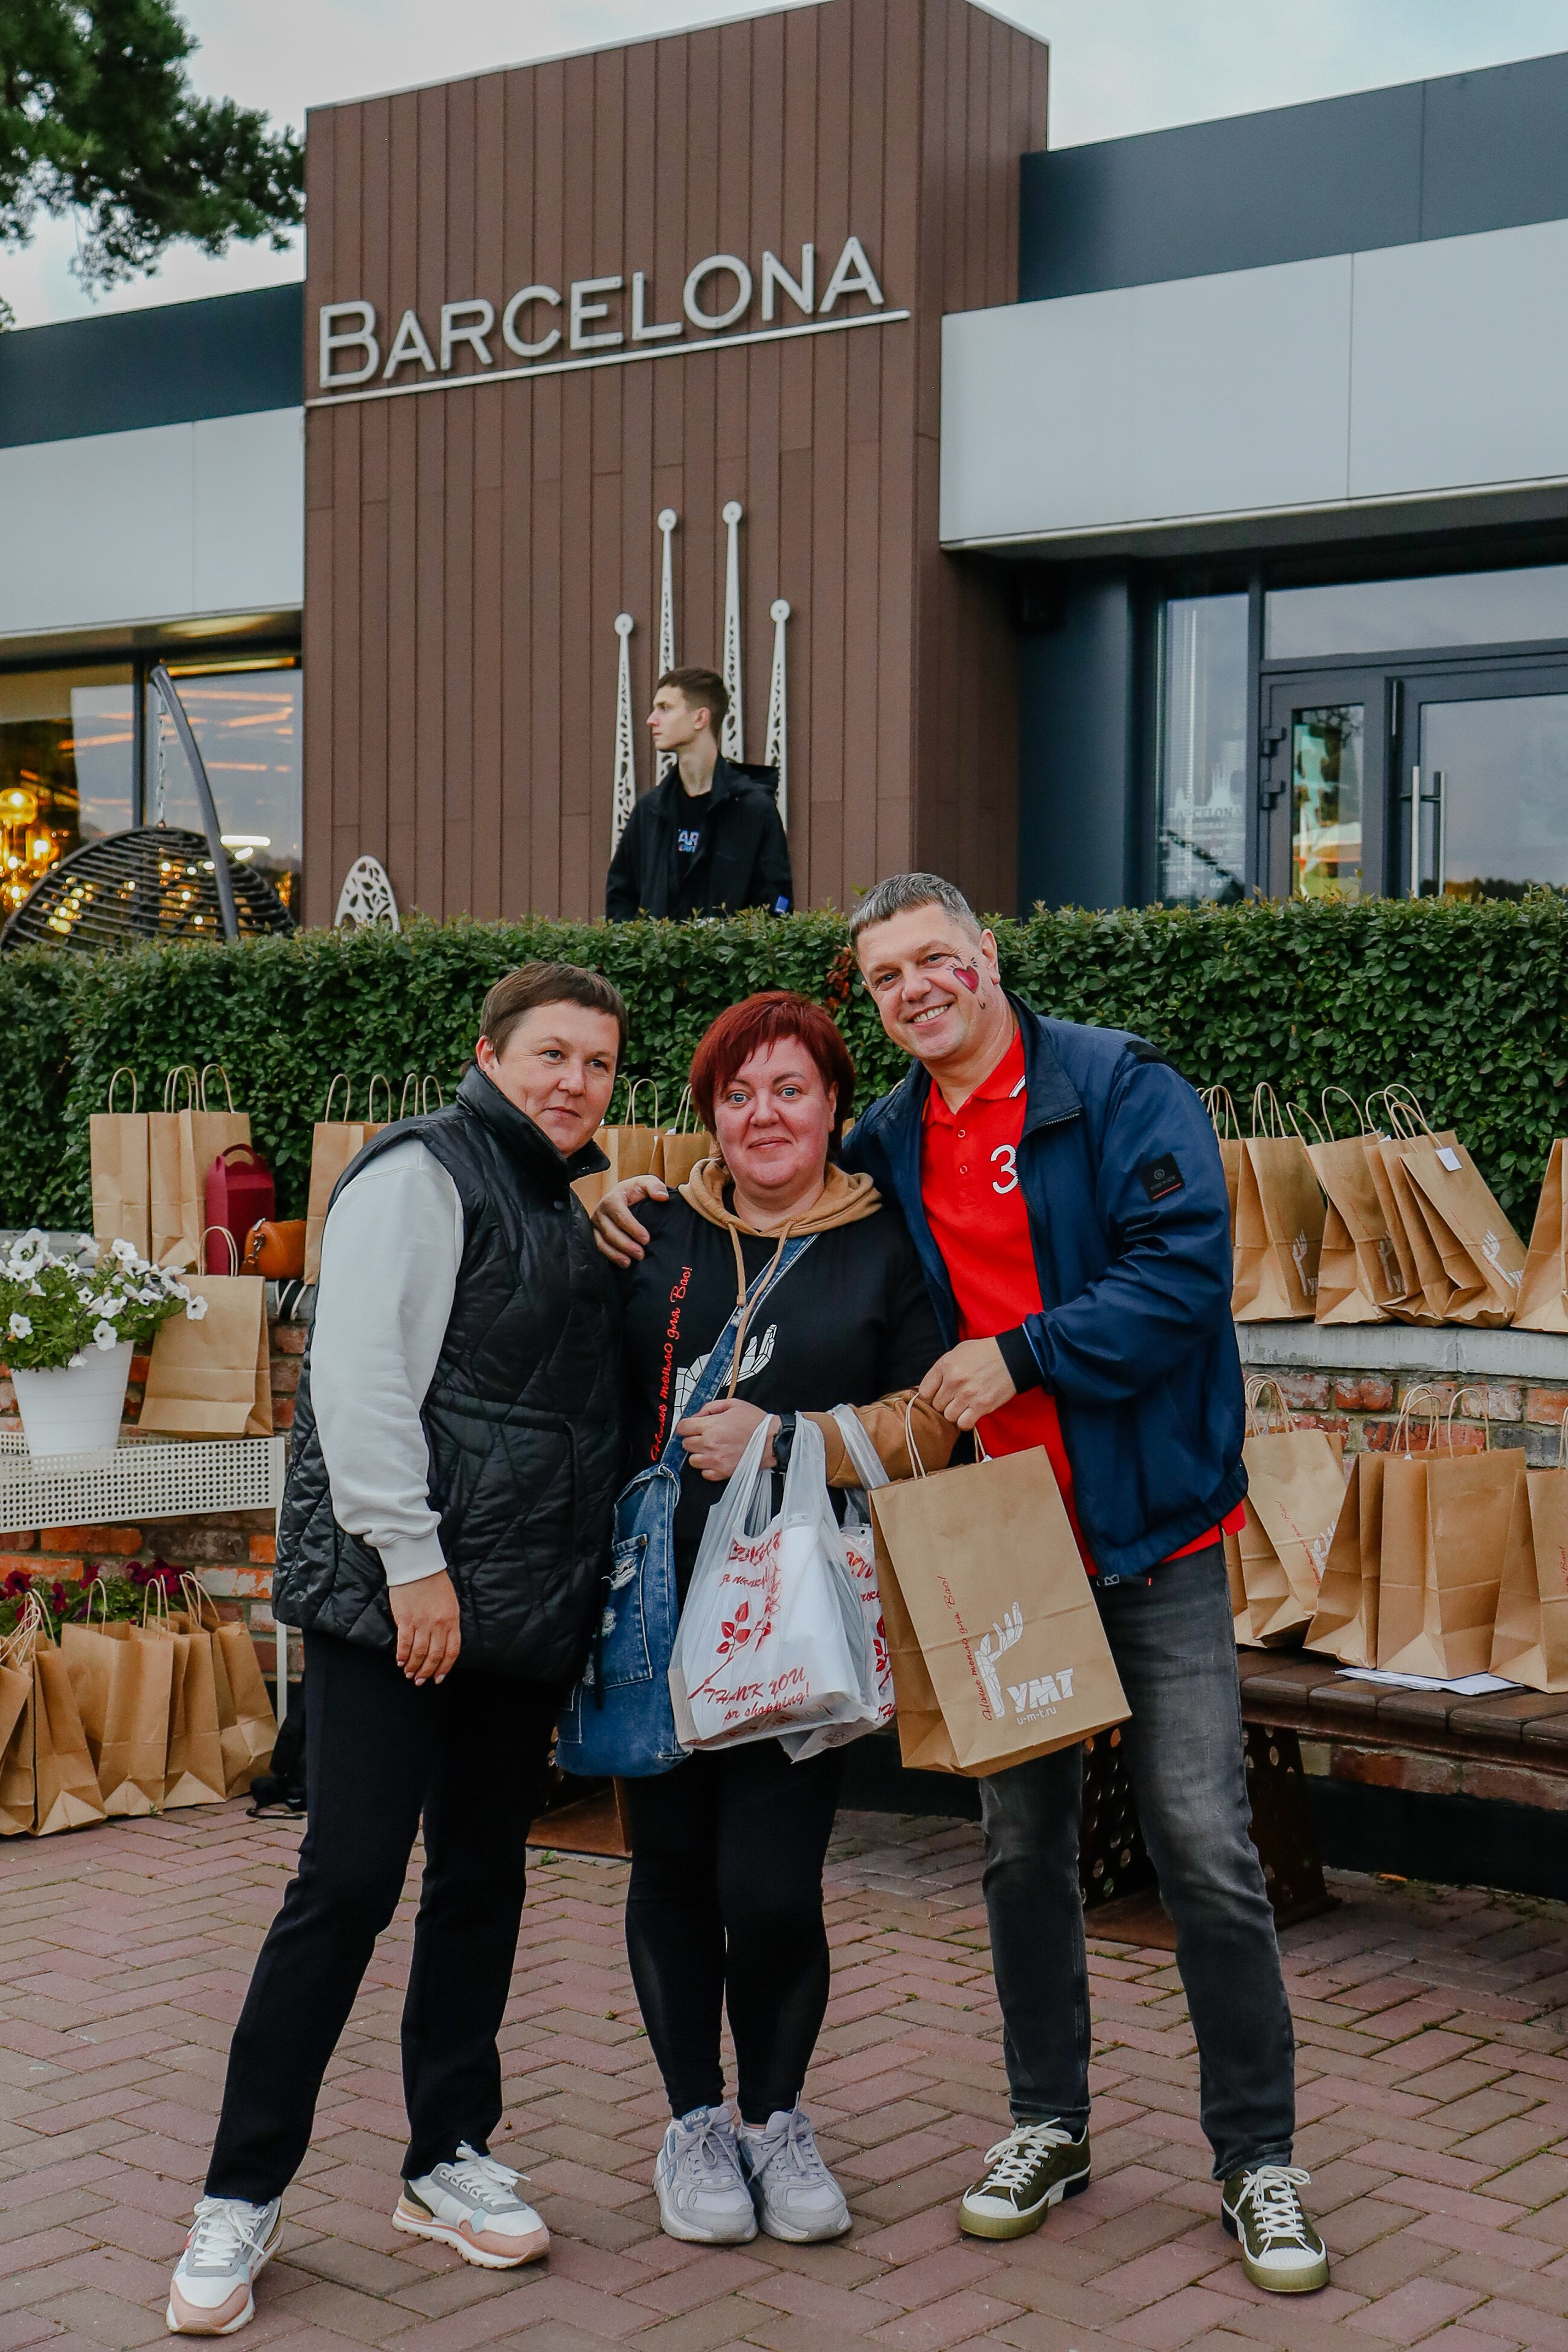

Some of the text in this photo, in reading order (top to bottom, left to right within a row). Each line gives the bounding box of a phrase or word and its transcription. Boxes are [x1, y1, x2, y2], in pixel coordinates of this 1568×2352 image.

[318, 236, 884, 388] BARCELONA
[1168, 807, 1243, 819] ACELONA
[990, 1144, 1019, 1194] 3
[670, 1267, 693, 1303] Вас!
[667, 1308, 681, 1340] для
[660, 1343, 673, 1400] тепло
[937, 1575, 992, 1721] Наше тепло для Вас!
[703, 1683, 764, 1706] THANK
[1006, 1667, 1074, 1713] УМТ
[1016, 1706, 1058, 1725] u-m-t.ru
[685, 2111, 705, 2125] FILA
